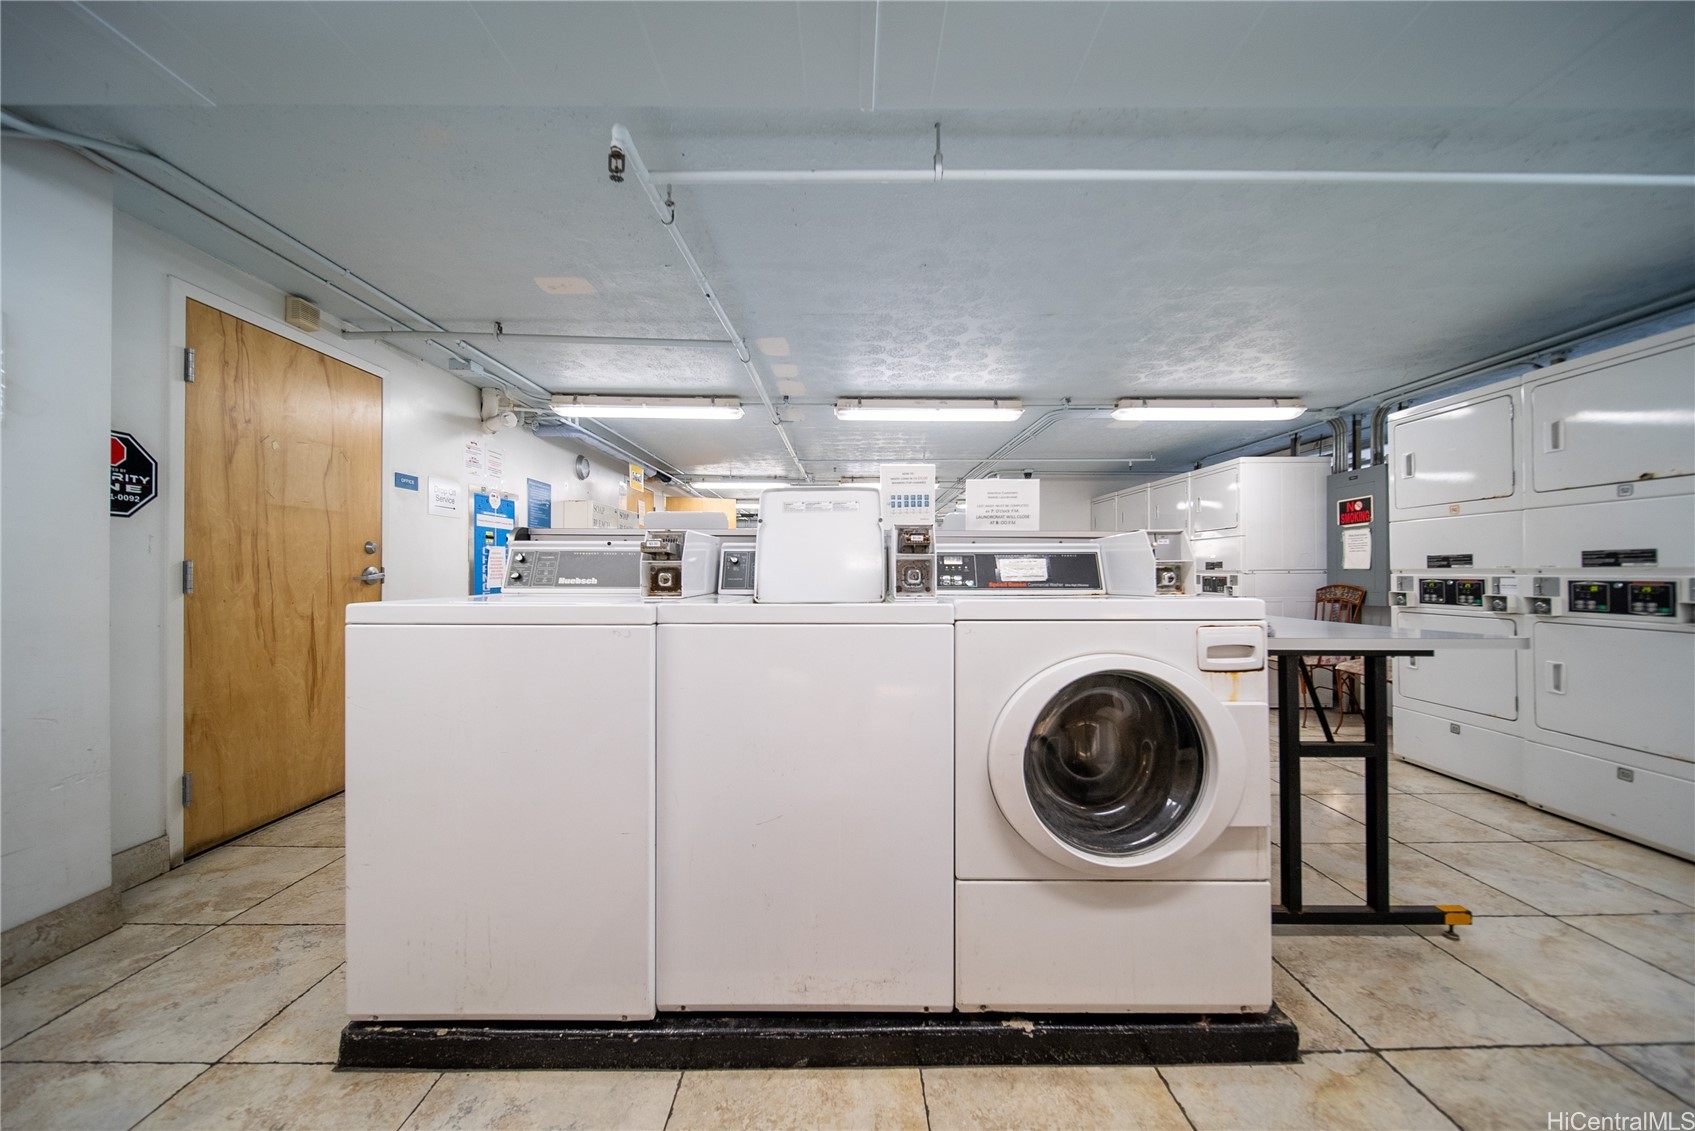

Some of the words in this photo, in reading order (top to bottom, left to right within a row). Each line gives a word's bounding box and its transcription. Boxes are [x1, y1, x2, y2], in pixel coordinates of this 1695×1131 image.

[434, 485, 448, 495] Drop
[435, 495, 456, 504] Service
[1341, 510, 1370, 523] SMOKING
[558, 577, 598, 585] Huebsch
